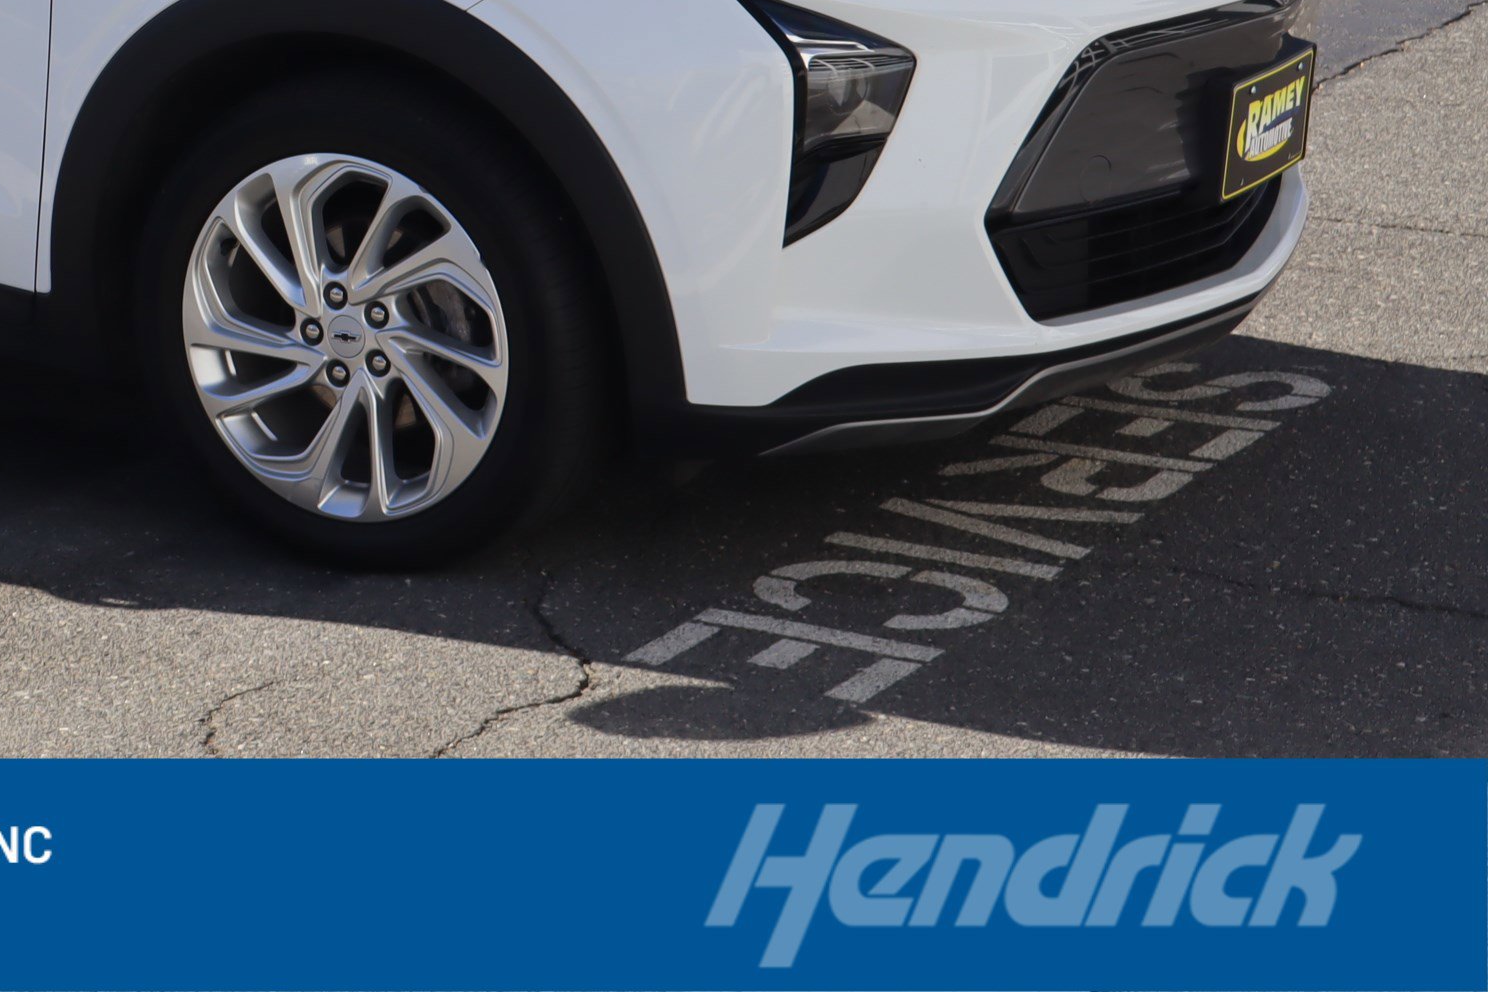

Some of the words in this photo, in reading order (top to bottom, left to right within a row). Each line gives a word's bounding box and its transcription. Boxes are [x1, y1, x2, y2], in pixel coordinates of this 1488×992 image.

[1244, 75, 1306, 154] RAMEY
[1248, 116, 1294, 159] AUTOMOTIVE
[623, 362, 1332, 703] SERVICE
